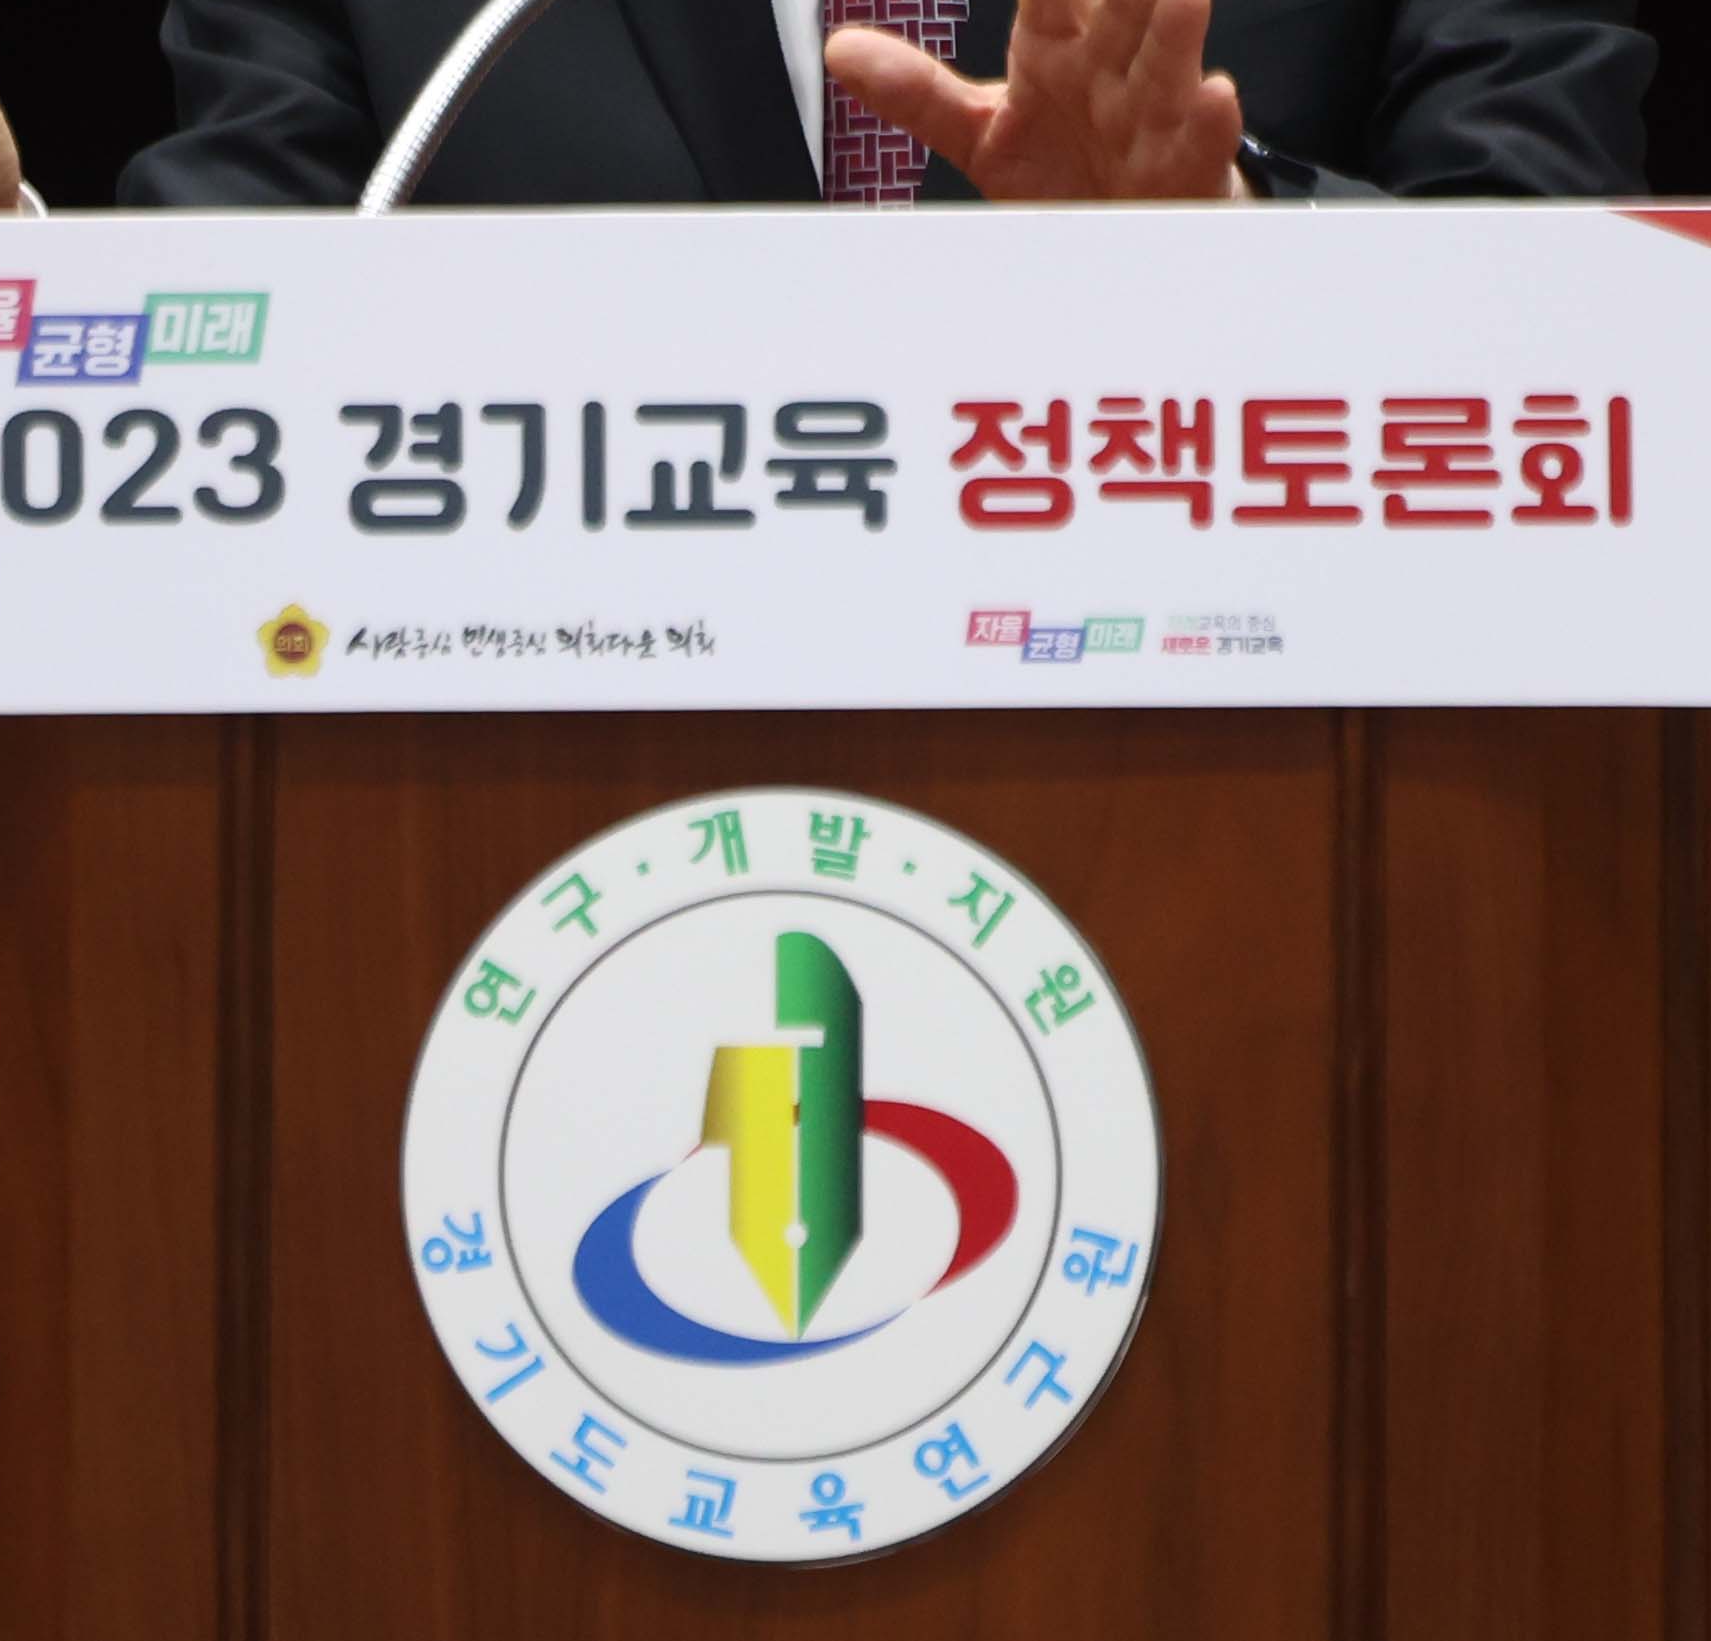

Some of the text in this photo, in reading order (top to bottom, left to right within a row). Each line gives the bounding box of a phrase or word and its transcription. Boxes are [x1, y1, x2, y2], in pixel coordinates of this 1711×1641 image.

[31, 320, 138, 378] 균형
[149, 300, 258, 356] 미래
[338, 399, 897, 534] 경기교육
[948, 393, 1634, 532] 정책토론회
[664, 618, 716, 659] 의회
[971, 614, 1138, 660] 자율 균형 미래
[1215, 635, 1285, 656] 경기교육
[420, 1210, 1139, 1541] 경기도교육연구원
